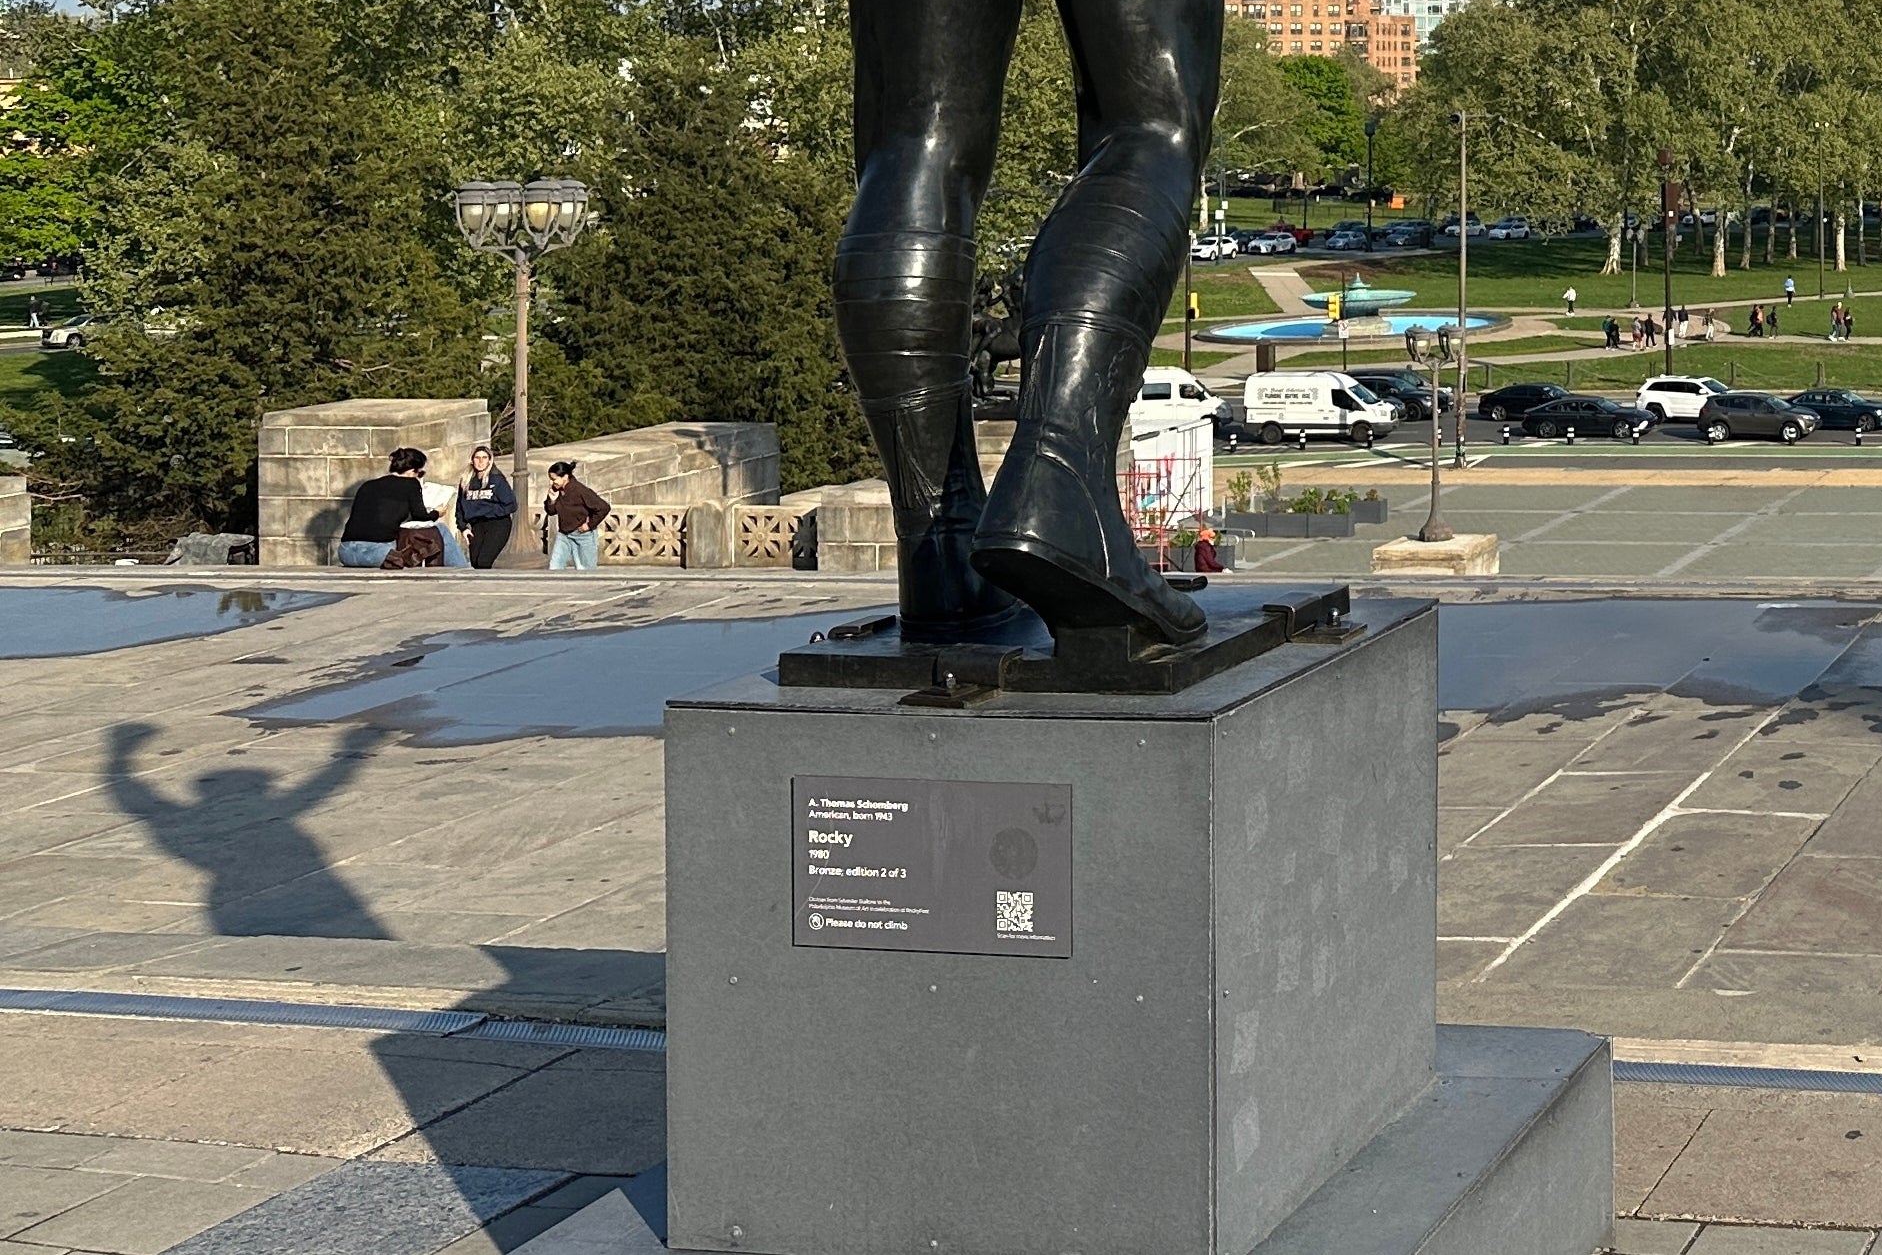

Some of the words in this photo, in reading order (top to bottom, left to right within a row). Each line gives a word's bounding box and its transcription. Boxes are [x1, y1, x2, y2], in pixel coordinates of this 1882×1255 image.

[808, 798, 819, 806] A.
[820, 799, 855, 808] Thomas
[857, 800, 908, 812] Schomberg
[808, 810, 851, 820] American,
[853, 811, 873, 820] born
[875, 812, 892, 821] 1943
[808, 830, 853, 847] Rocky
[808, 850, 830, 859] 1980
[846, 867, 879, 877] edition
[881, 868, 886, 877] 2
[888, 868, 899, 877] of
[900, 869, 906, 878] 3
[826, 918, 853, 927] Please
[855, 920, 866, 928] do
[868, 921, 883, 929] not
[884, 921, 908, 930] climb
